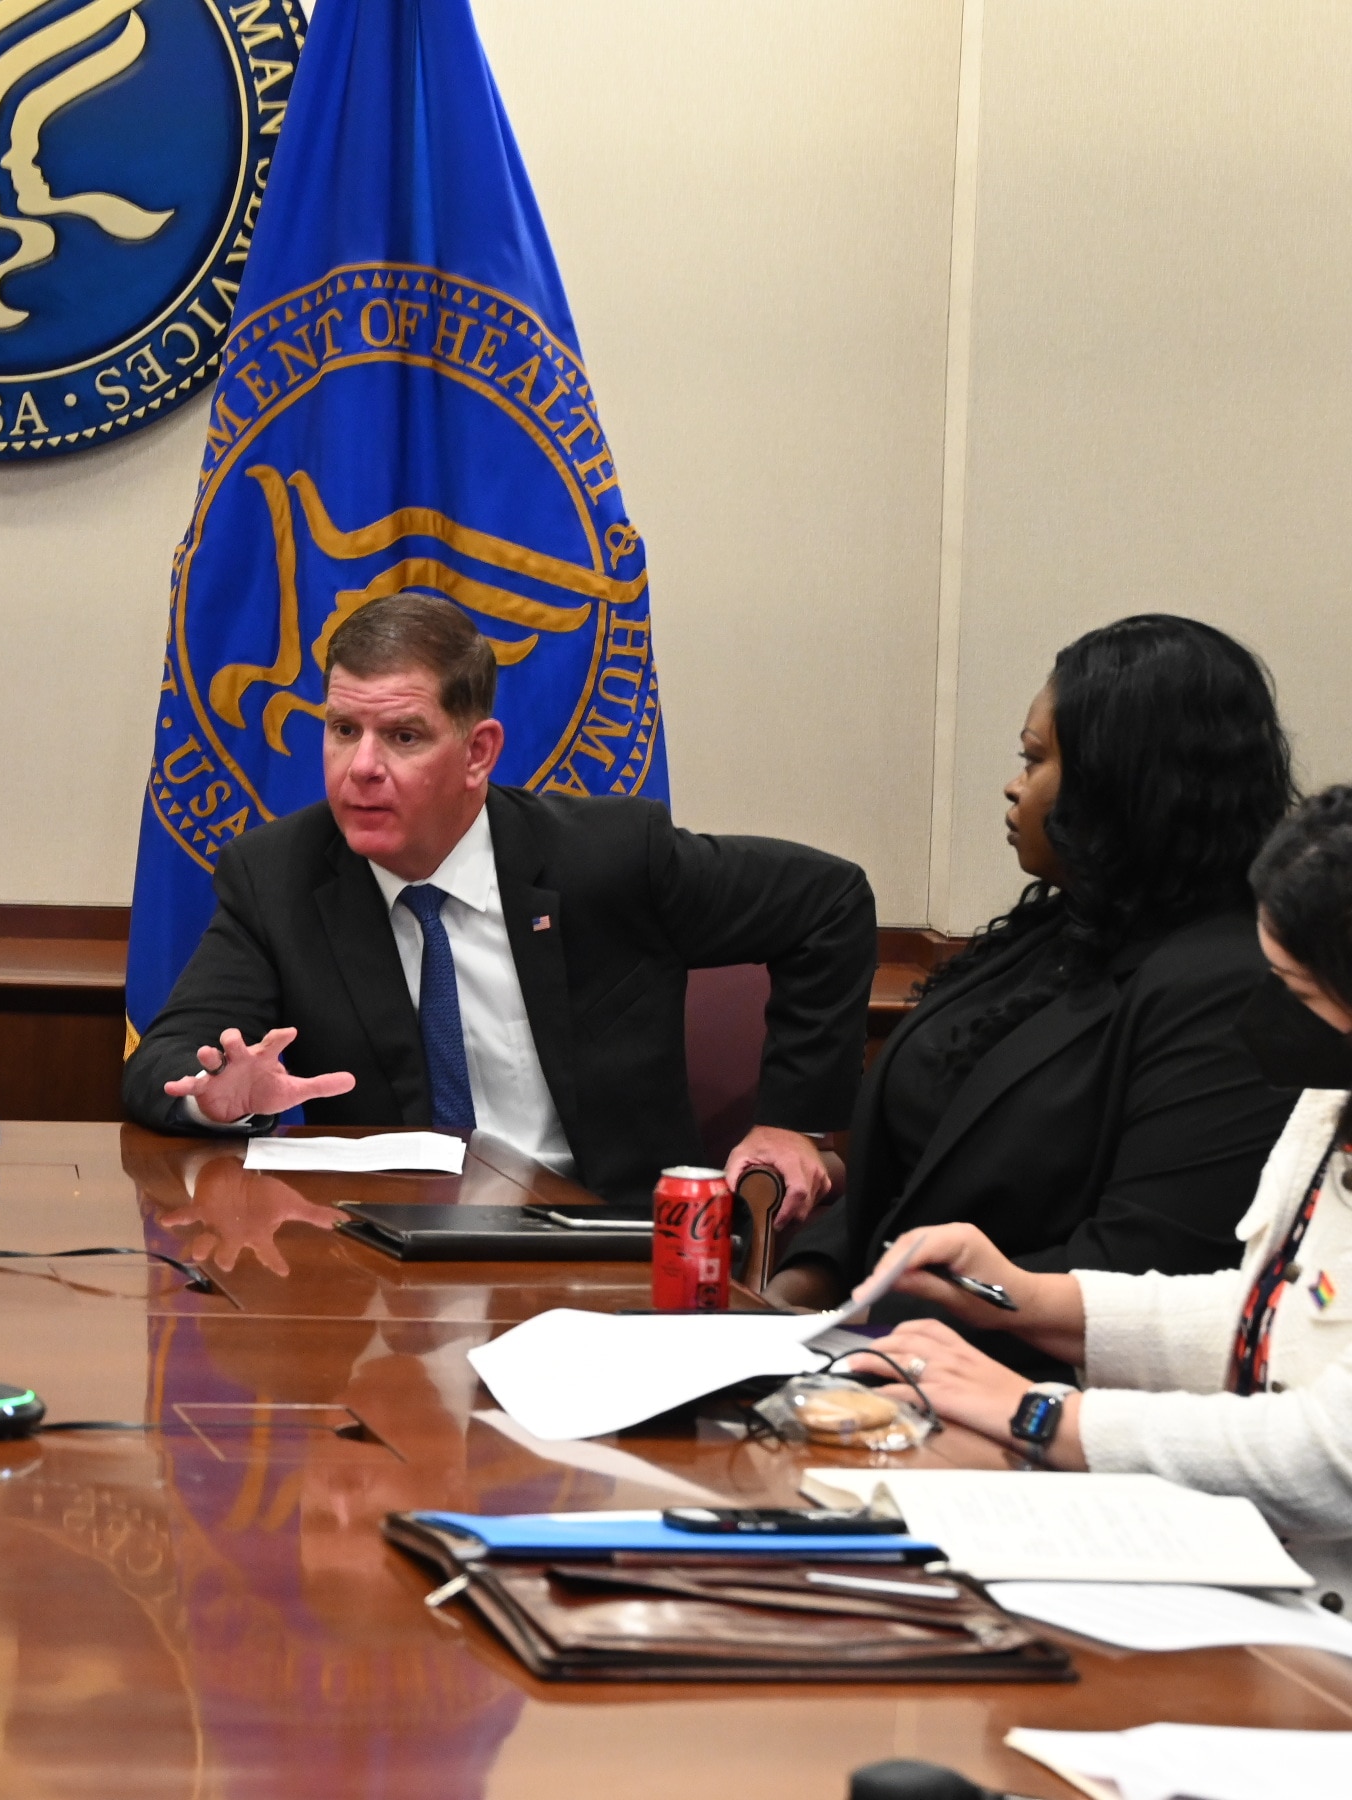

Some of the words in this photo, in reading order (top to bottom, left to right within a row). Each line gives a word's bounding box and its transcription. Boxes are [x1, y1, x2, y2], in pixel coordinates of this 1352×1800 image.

[229, 0, 294, 134] MAN
[360, 298, 427, 348] OF
[433, 300, 616, 505] HEALTH
[604, 523, 640, 571] &
[537, 610, 651, 797] HUMA
[163, 733, 250, 836] USA
